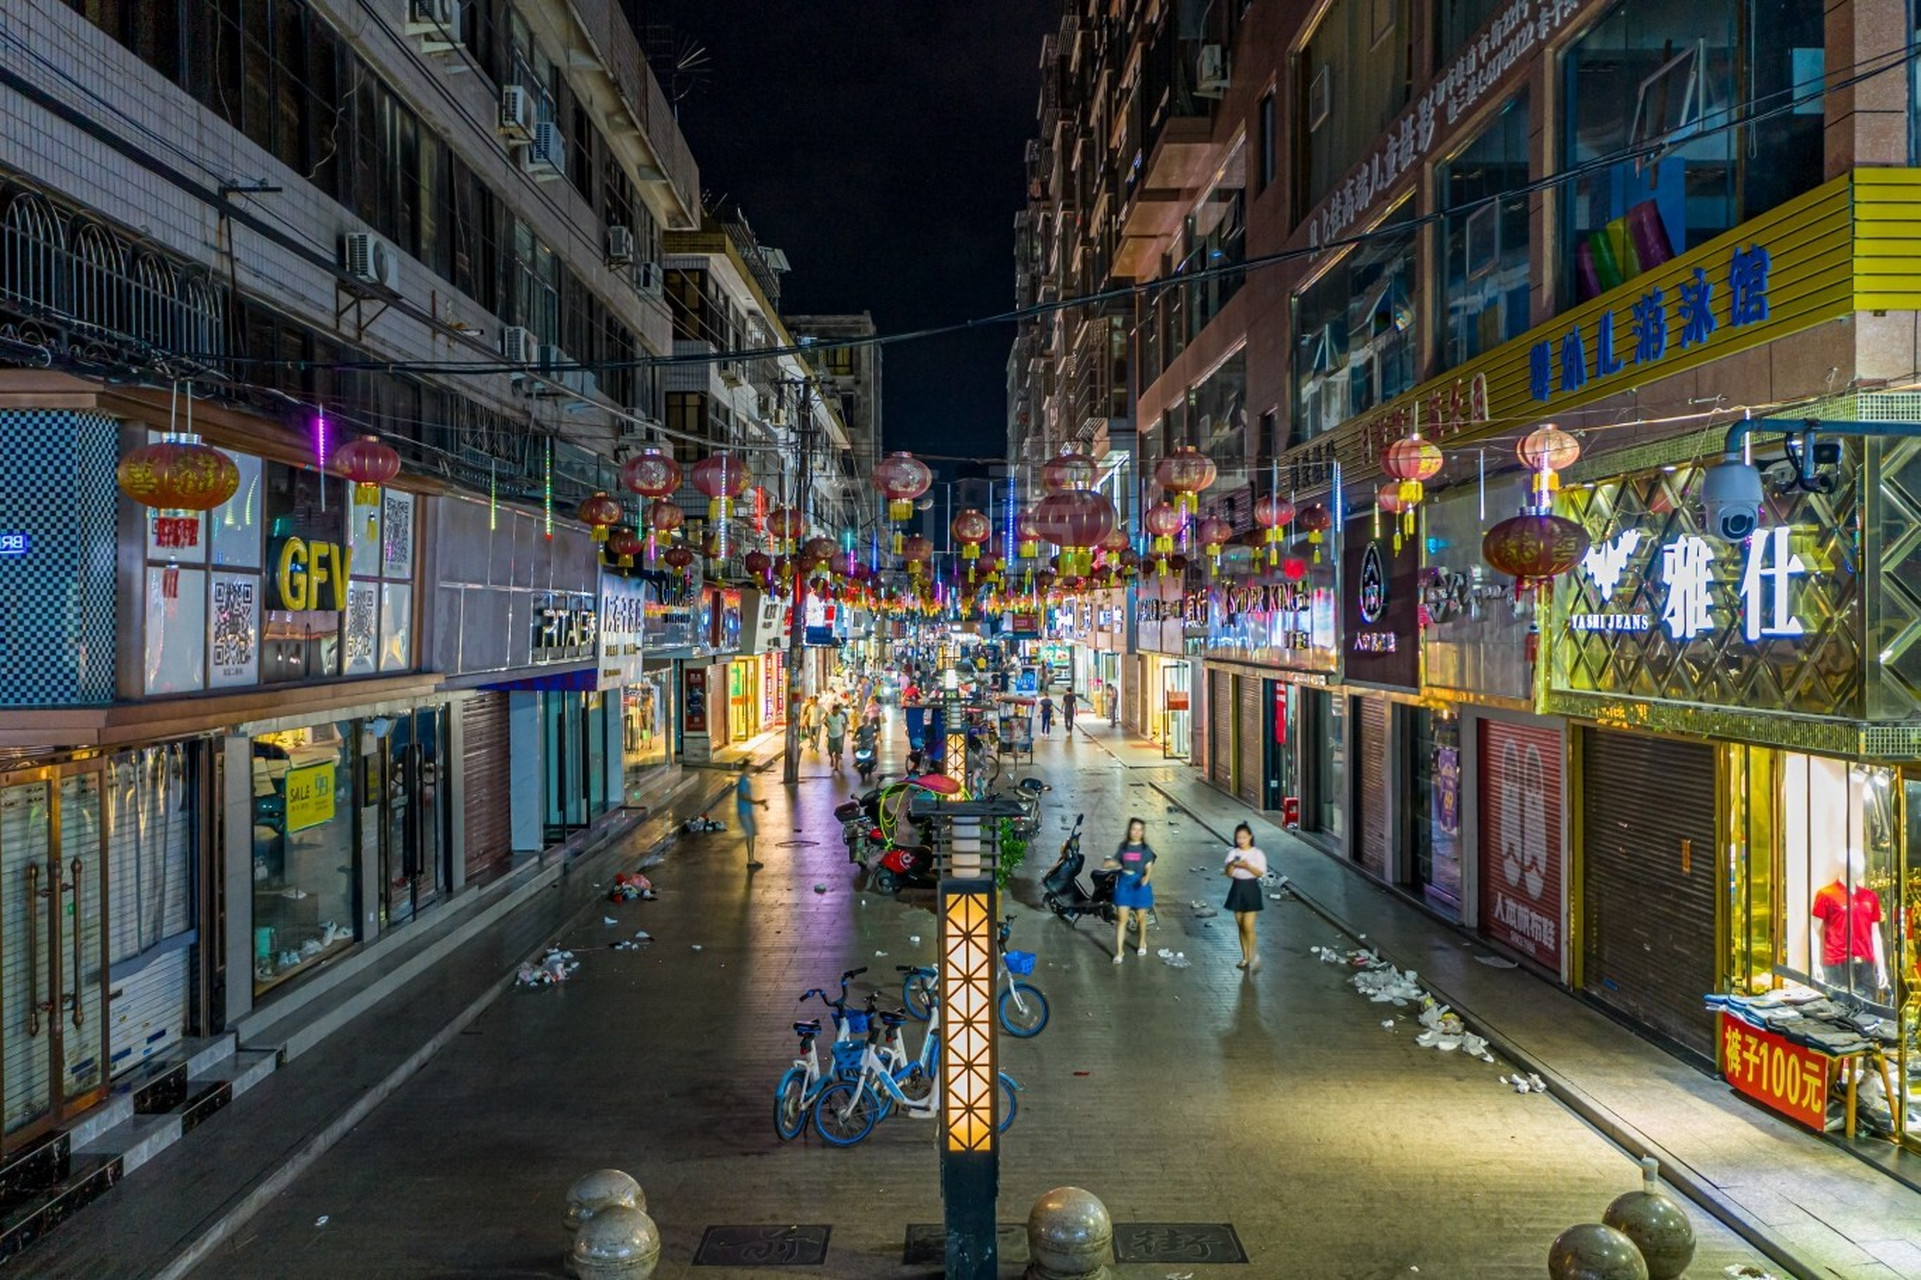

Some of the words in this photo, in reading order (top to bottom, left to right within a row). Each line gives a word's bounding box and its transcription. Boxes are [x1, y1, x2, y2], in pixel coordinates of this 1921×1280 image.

[1529, 243, 1772, 402] 婴幼儿游泳馆
[279, 536, 353, 611] GFV
[1662, 527, 1806, 642] 雅仕
[1571, 615, 1606, 631] YASHI
[1608, 615, 1649, 631] JEANS
[290, 785, 310, 803] SALE
[1724, 1025, 1823, 1115] 裤子100元
